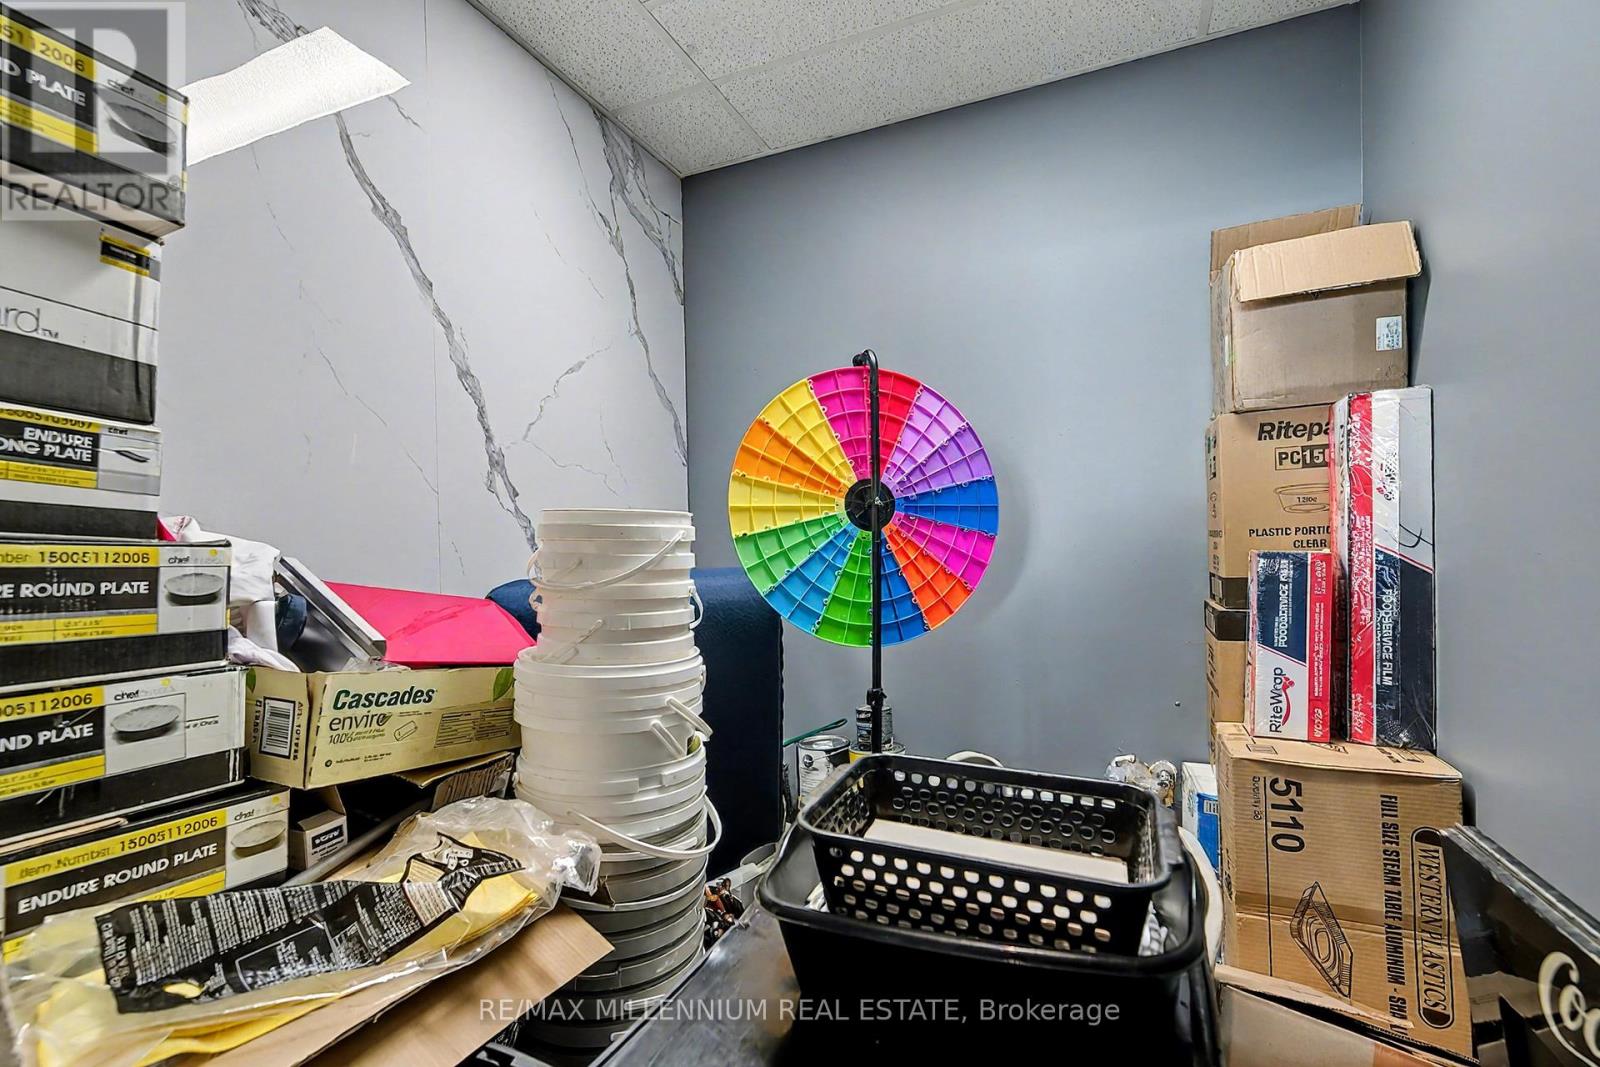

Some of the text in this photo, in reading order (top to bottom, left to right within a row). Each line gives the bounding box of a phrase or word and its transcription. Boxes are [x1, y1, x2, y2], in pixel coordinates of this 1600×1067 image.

[0, 24, 86, 73] 5112006
[0, 56, 87, 107] D PLATE
[0, 307, 41, 334] rd
[23, 427, 93, 448] ENDURE
[43, 444, 92, 462] PLATE
[1249, 527, 1292, 538] PLASTIC
[1293, 538, 1327, 549] CLEAR
[0, 581, 150, 598] E ROUND PLATE
[1381, 662, 1393, 686] FILM
[0, 693, 93, 717] 05112006
[332, 686, 435, 710] Cascades
[1269, 667, 1287, 733] RiteWrap
[38, 723, 94, 746] PLATE
[1269, 777, 1306, 853] 5110
[1380, 794, 1399, 818] FULL
[119, 816, 218, 852] 15005112006
[1381, 822, 1400, 846] SIZE
[17, 842, 218, 914] ENDURE ROUND PLATE
[1383, 849, 1401, 886] STEAM
[1384, 890, 1402, 921] TABLE
[1418, 848, 1446, 1011] WESTERN PLASTICS
[1385, 923, 1405, 985] ALUMINUM
